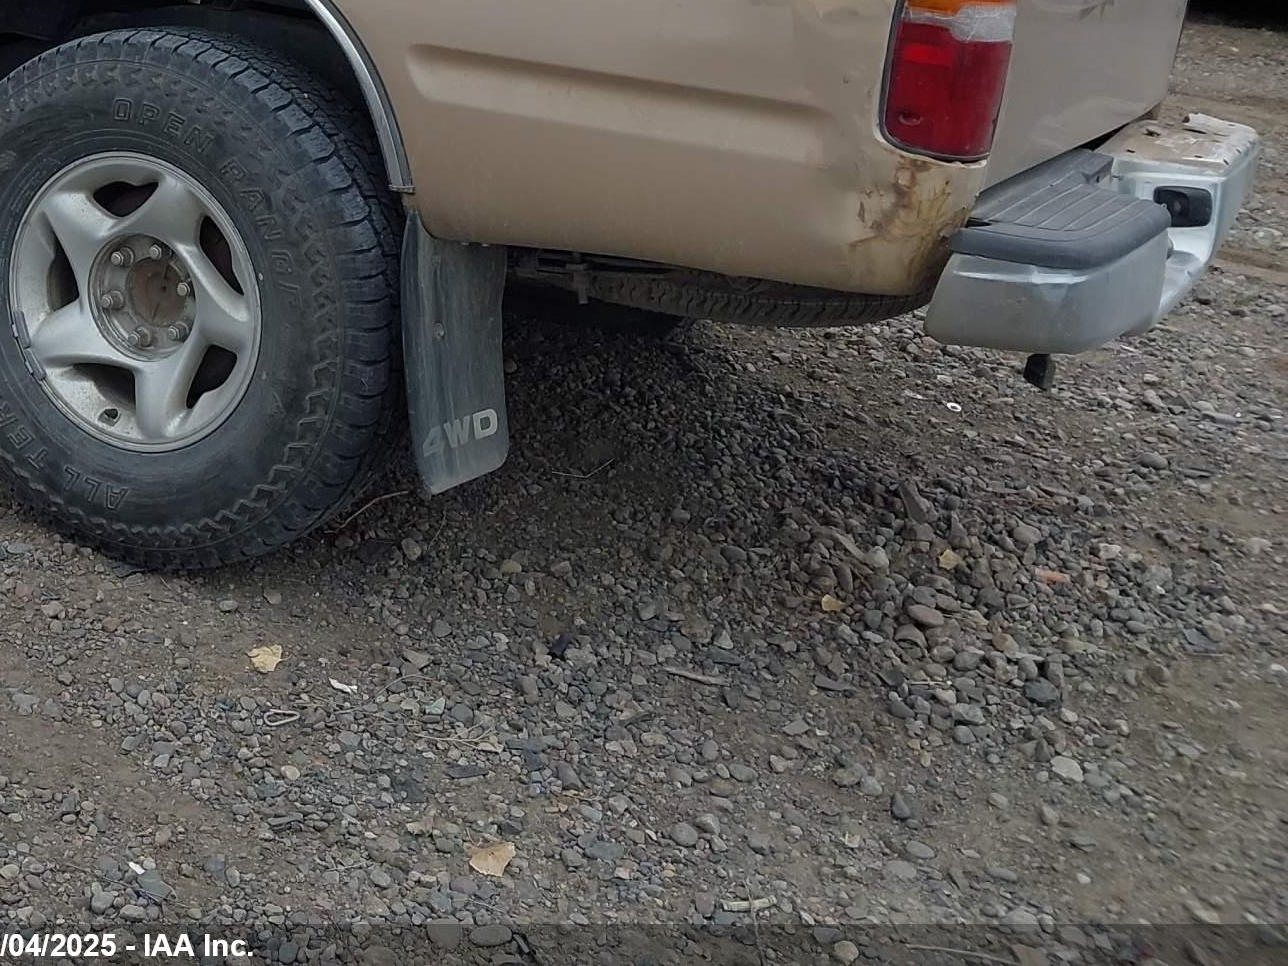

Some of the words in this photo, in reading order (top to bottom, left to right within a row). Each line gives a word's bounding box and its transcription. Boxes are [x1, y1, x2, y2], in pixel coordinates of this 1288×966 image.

[112, 97, 216, 154] OPEN
[422, 408, 498, 458] 4WD
[63, 464, 129, 511] ALL
